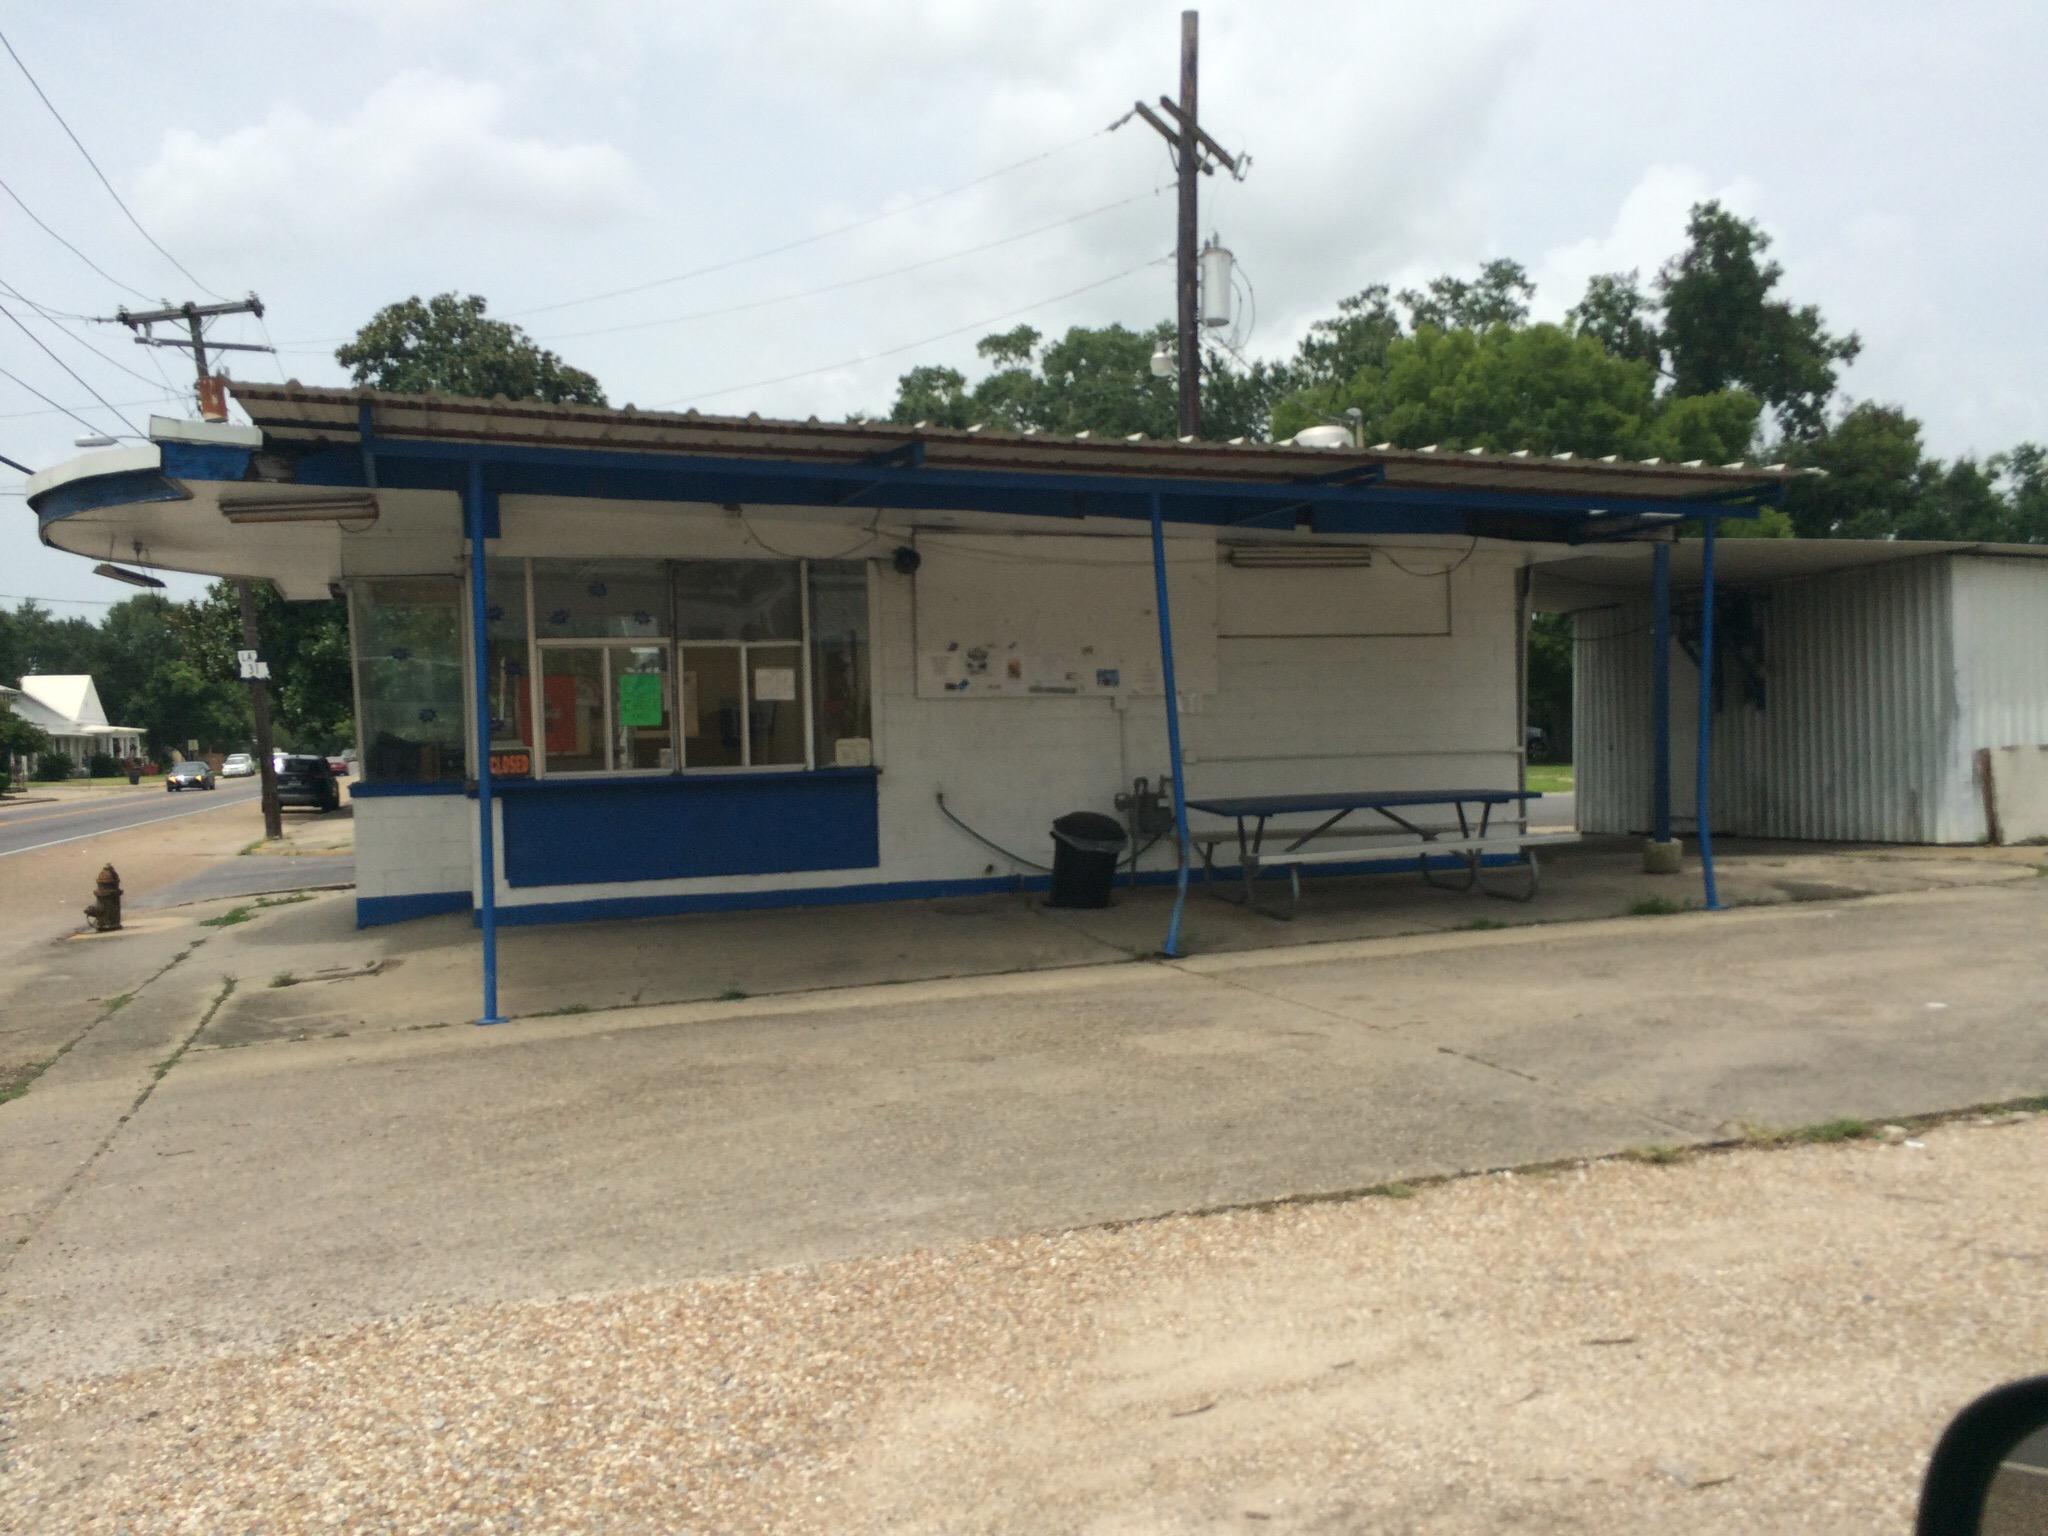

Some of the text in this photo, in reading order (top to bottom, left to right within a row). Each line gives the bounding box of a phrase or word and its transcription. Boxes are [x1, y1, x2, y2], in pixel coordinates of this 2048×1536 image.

[241, 652, 254, 662] LA
[248, 663, 260, 675] 31
[490, 754, 529, 774] CLOSED
